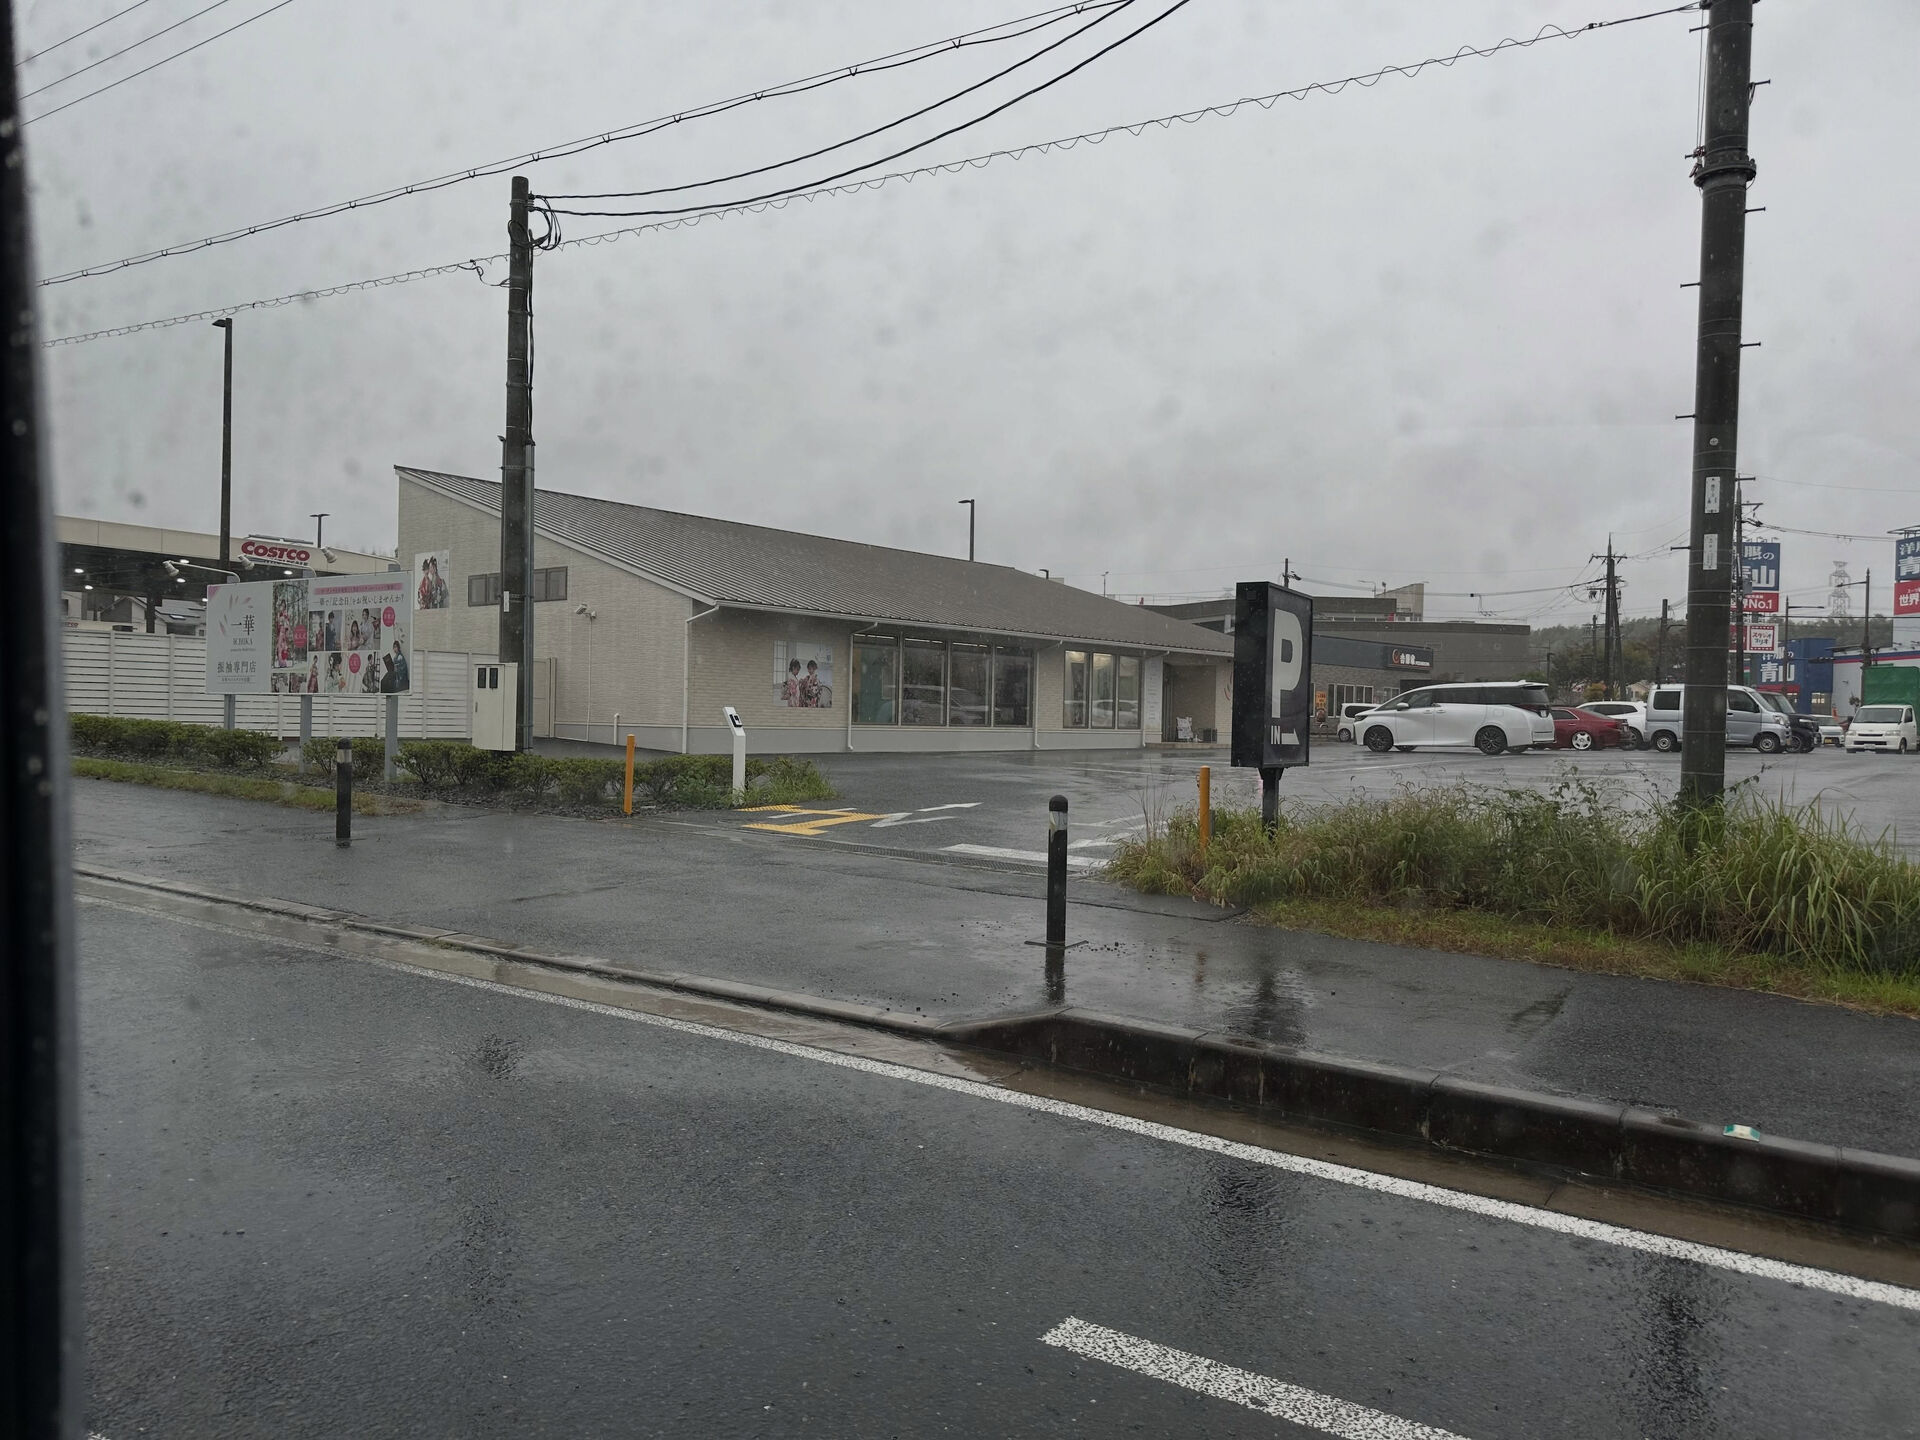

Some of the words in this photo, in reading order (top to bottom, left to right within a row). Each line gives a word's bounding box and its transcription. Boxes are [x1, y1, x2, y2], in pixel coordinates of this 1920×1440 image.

[241, 541, 311, 562] COSTCO
[1899, 541, 1920, 556] 洋
[231, 614, 255, 635] 一華
[1271, 608, 1303, 719] P
[1760, 662, 1795, 682] 青山
[1270, 725, 1281, 745] IN
